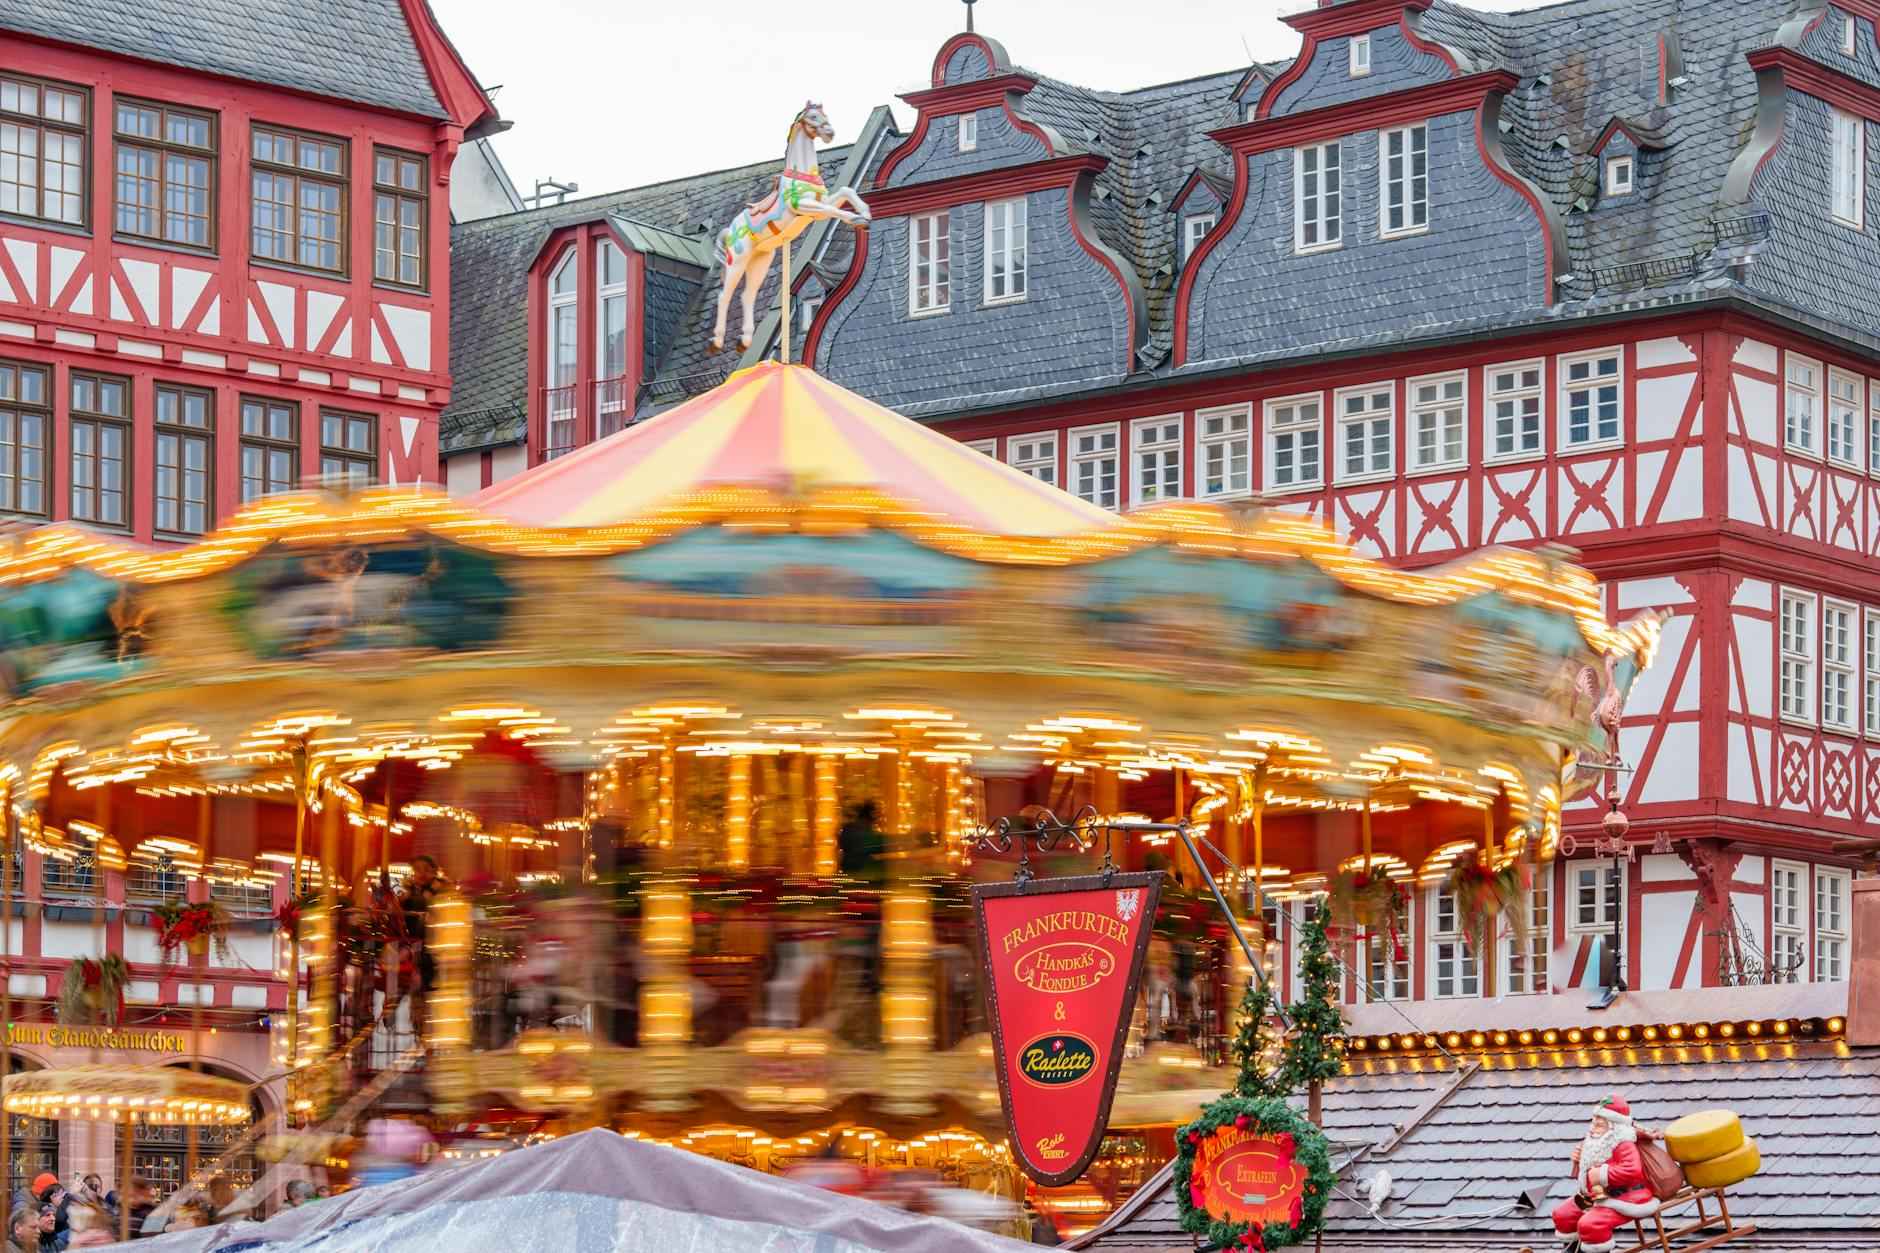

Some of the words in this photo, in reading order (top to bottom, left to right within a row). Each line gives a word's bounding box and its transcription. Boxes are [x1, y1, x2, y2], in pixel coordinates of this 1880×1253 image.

[1002, 911, 1129, 954] FRANKFURTER
[1039, 971, 1088, 991] FONDUE
[1053, 1000, 1067, 1021] &
[1025, 1048, 1091, 1072] Raclette
